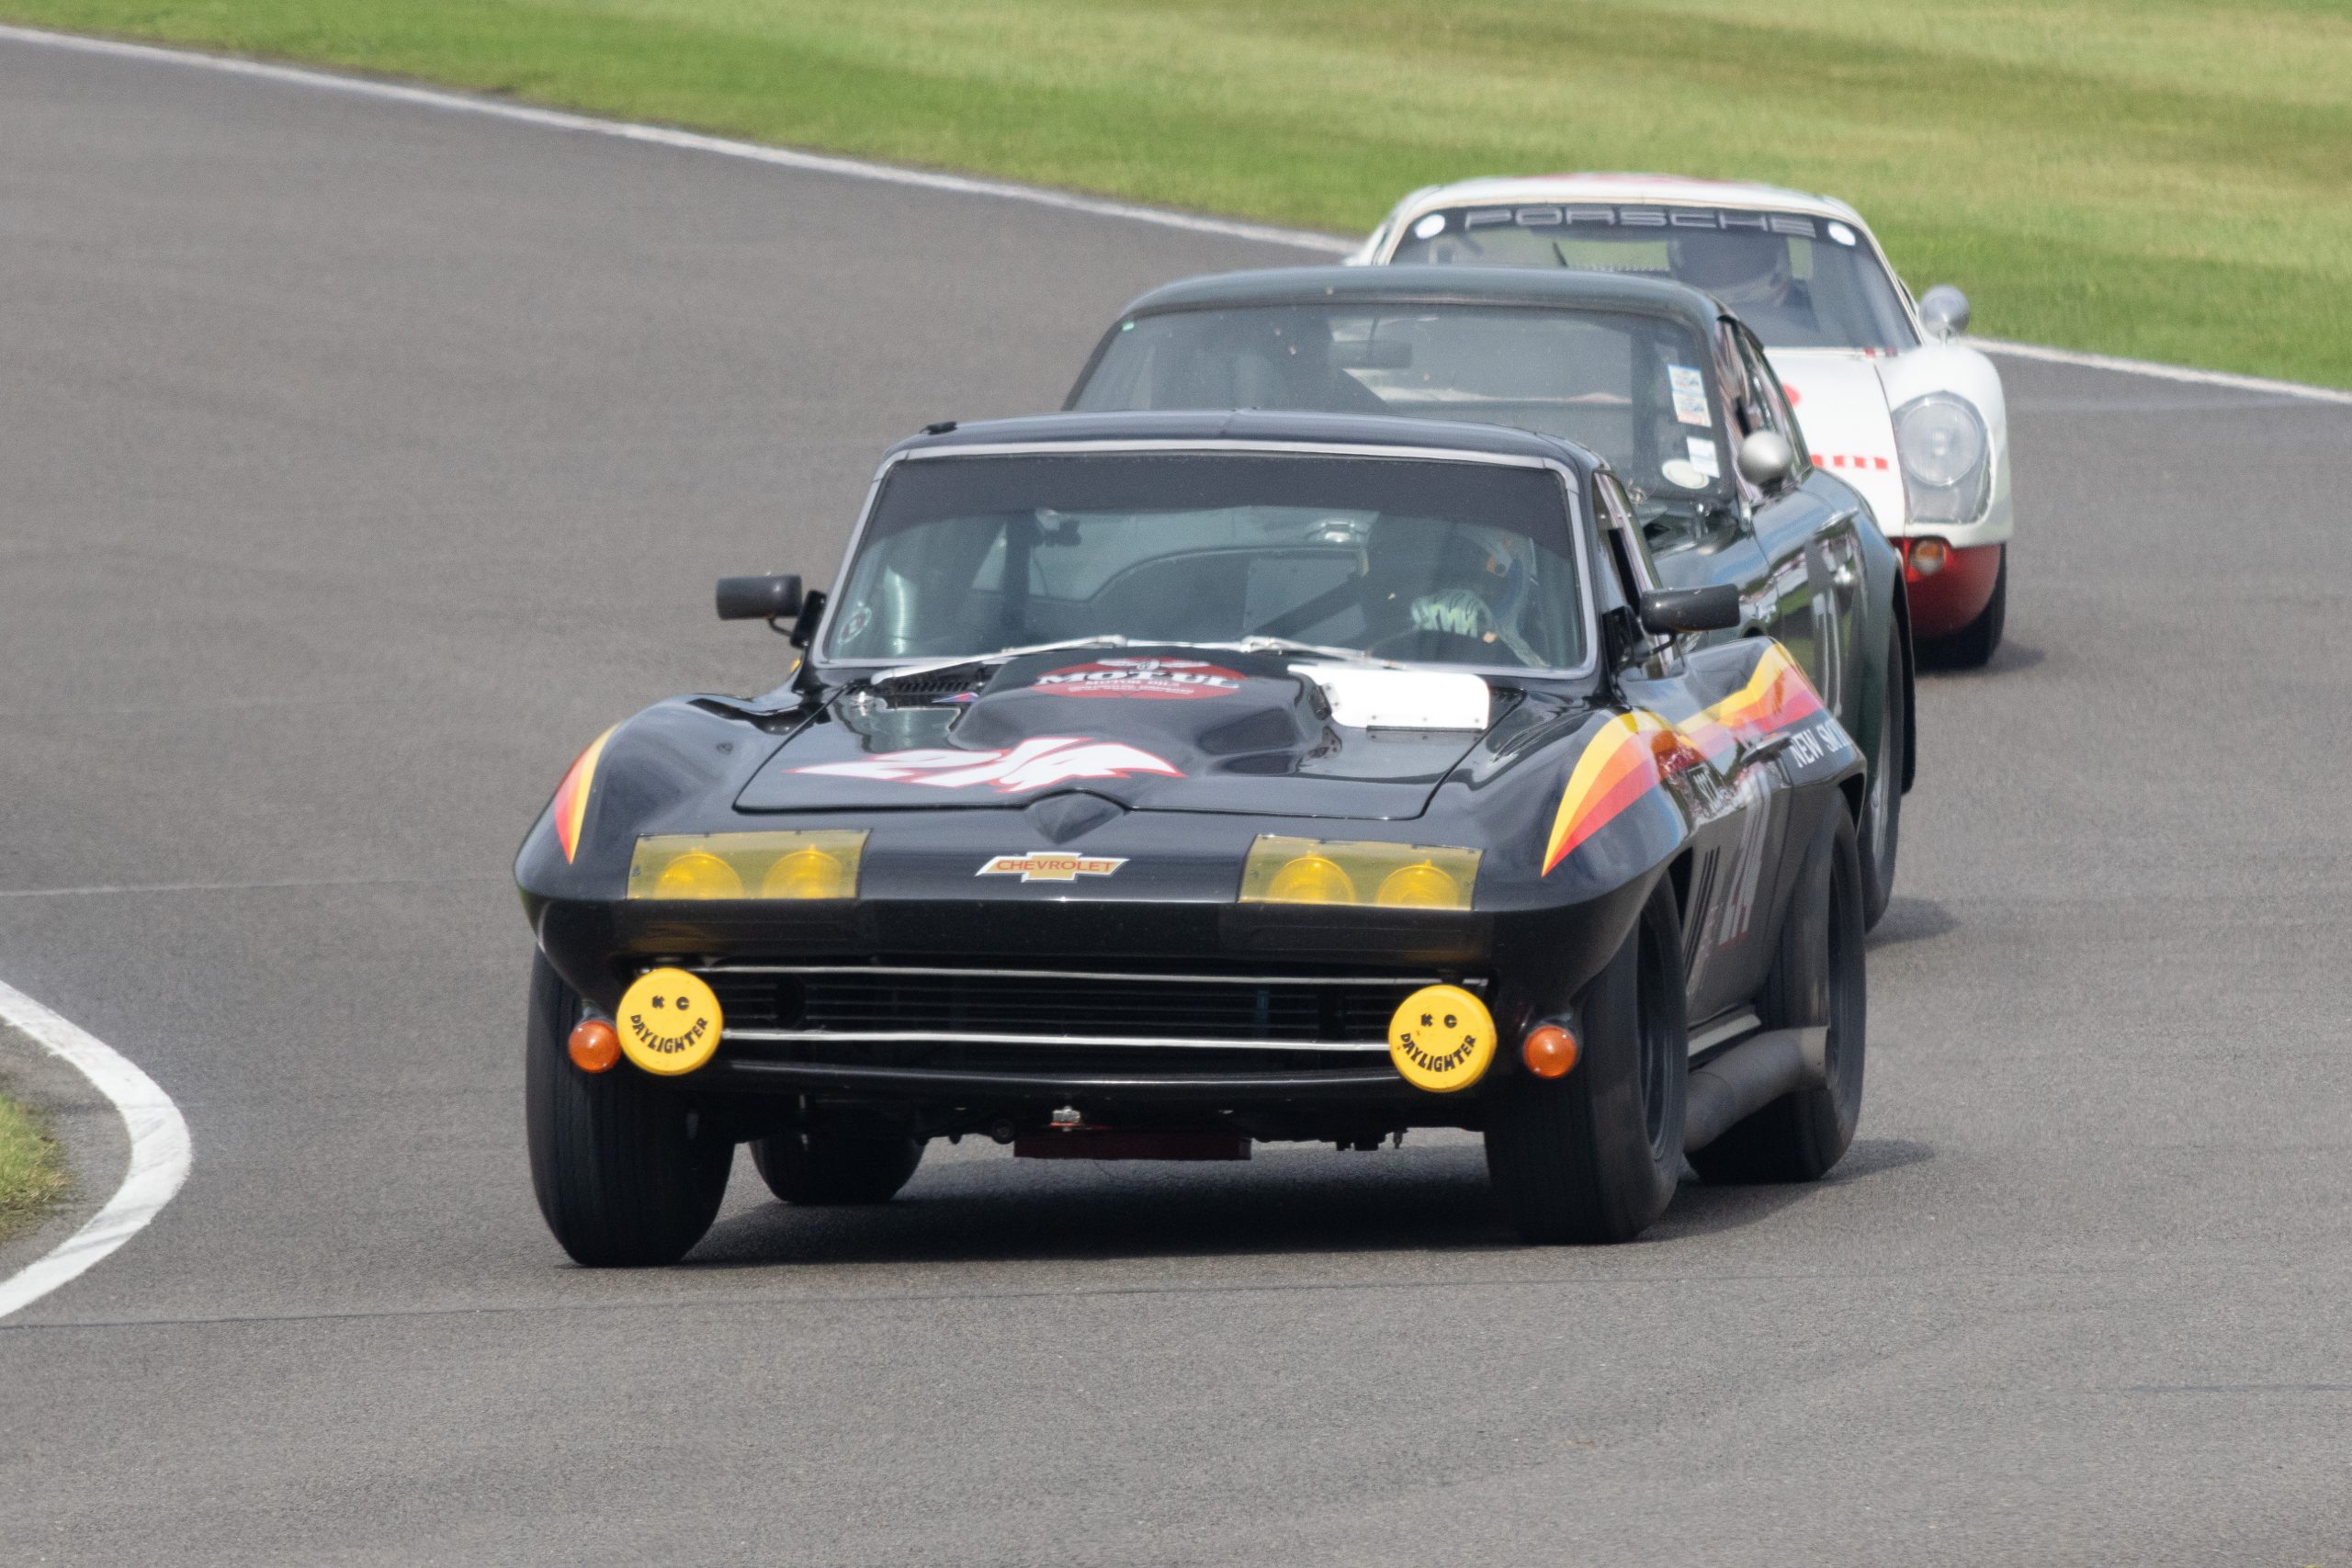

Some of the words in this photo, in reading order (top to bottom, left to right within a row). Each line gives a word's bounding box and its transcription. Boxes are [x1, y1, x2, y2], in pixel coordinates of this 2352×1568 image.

[1464, 207, 1816, 239] PORSCHE
[1035, 671, 1239, 689] MOTUL
[1789, 728, 1824, 768] NEW
[996, 860, 1117, 872] CHEVROLET
[630, 1014, 708, 1055] DAYLIGHTER
[1400, 1032, 1476, 1073] DAYLIGHTER
